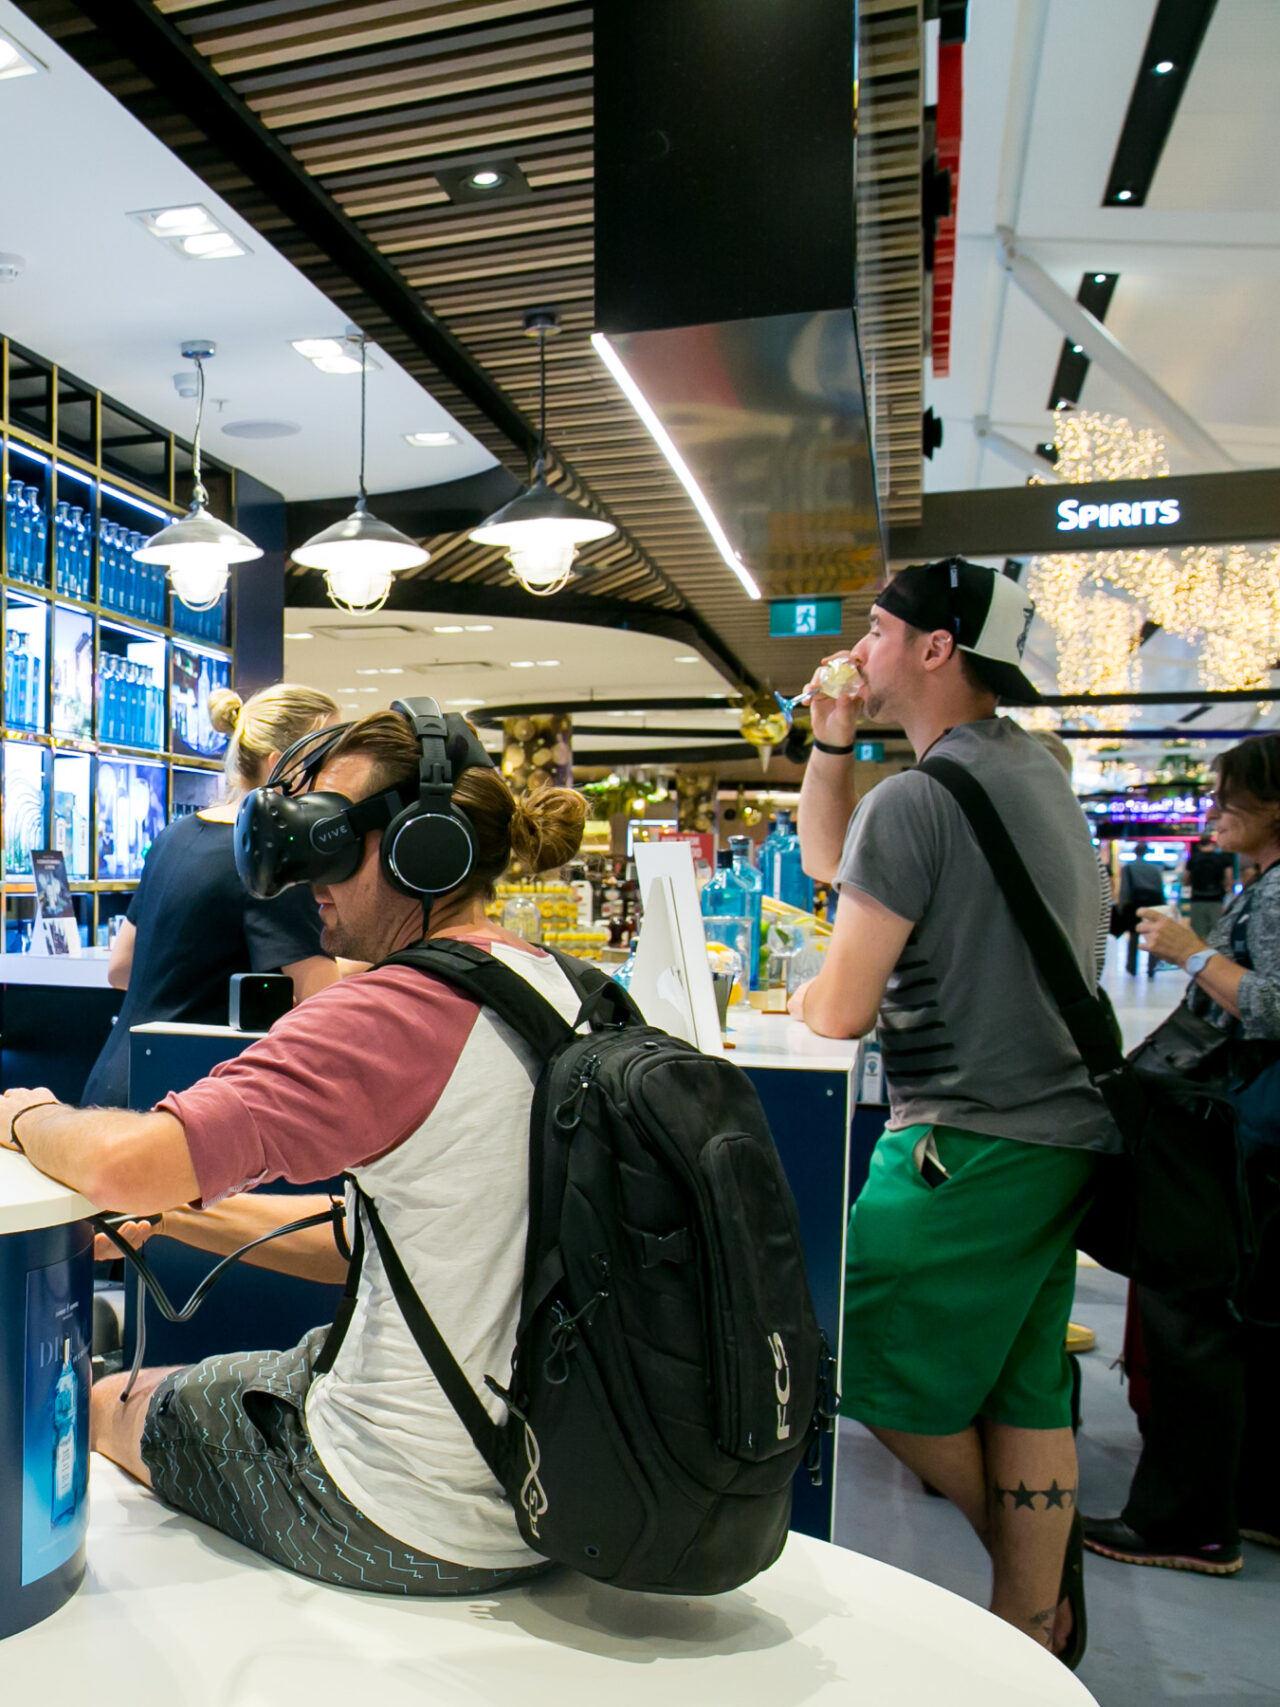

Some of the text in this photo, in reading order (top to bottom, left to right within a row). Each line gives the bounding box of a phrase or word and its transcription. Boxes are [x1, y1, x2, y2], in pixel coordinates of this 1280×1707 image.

[1057, 499, 1180, 531] SPIRITS
[319, 825, 347, 842] VIVE
[767, 1332, 790, 1440] FCS
